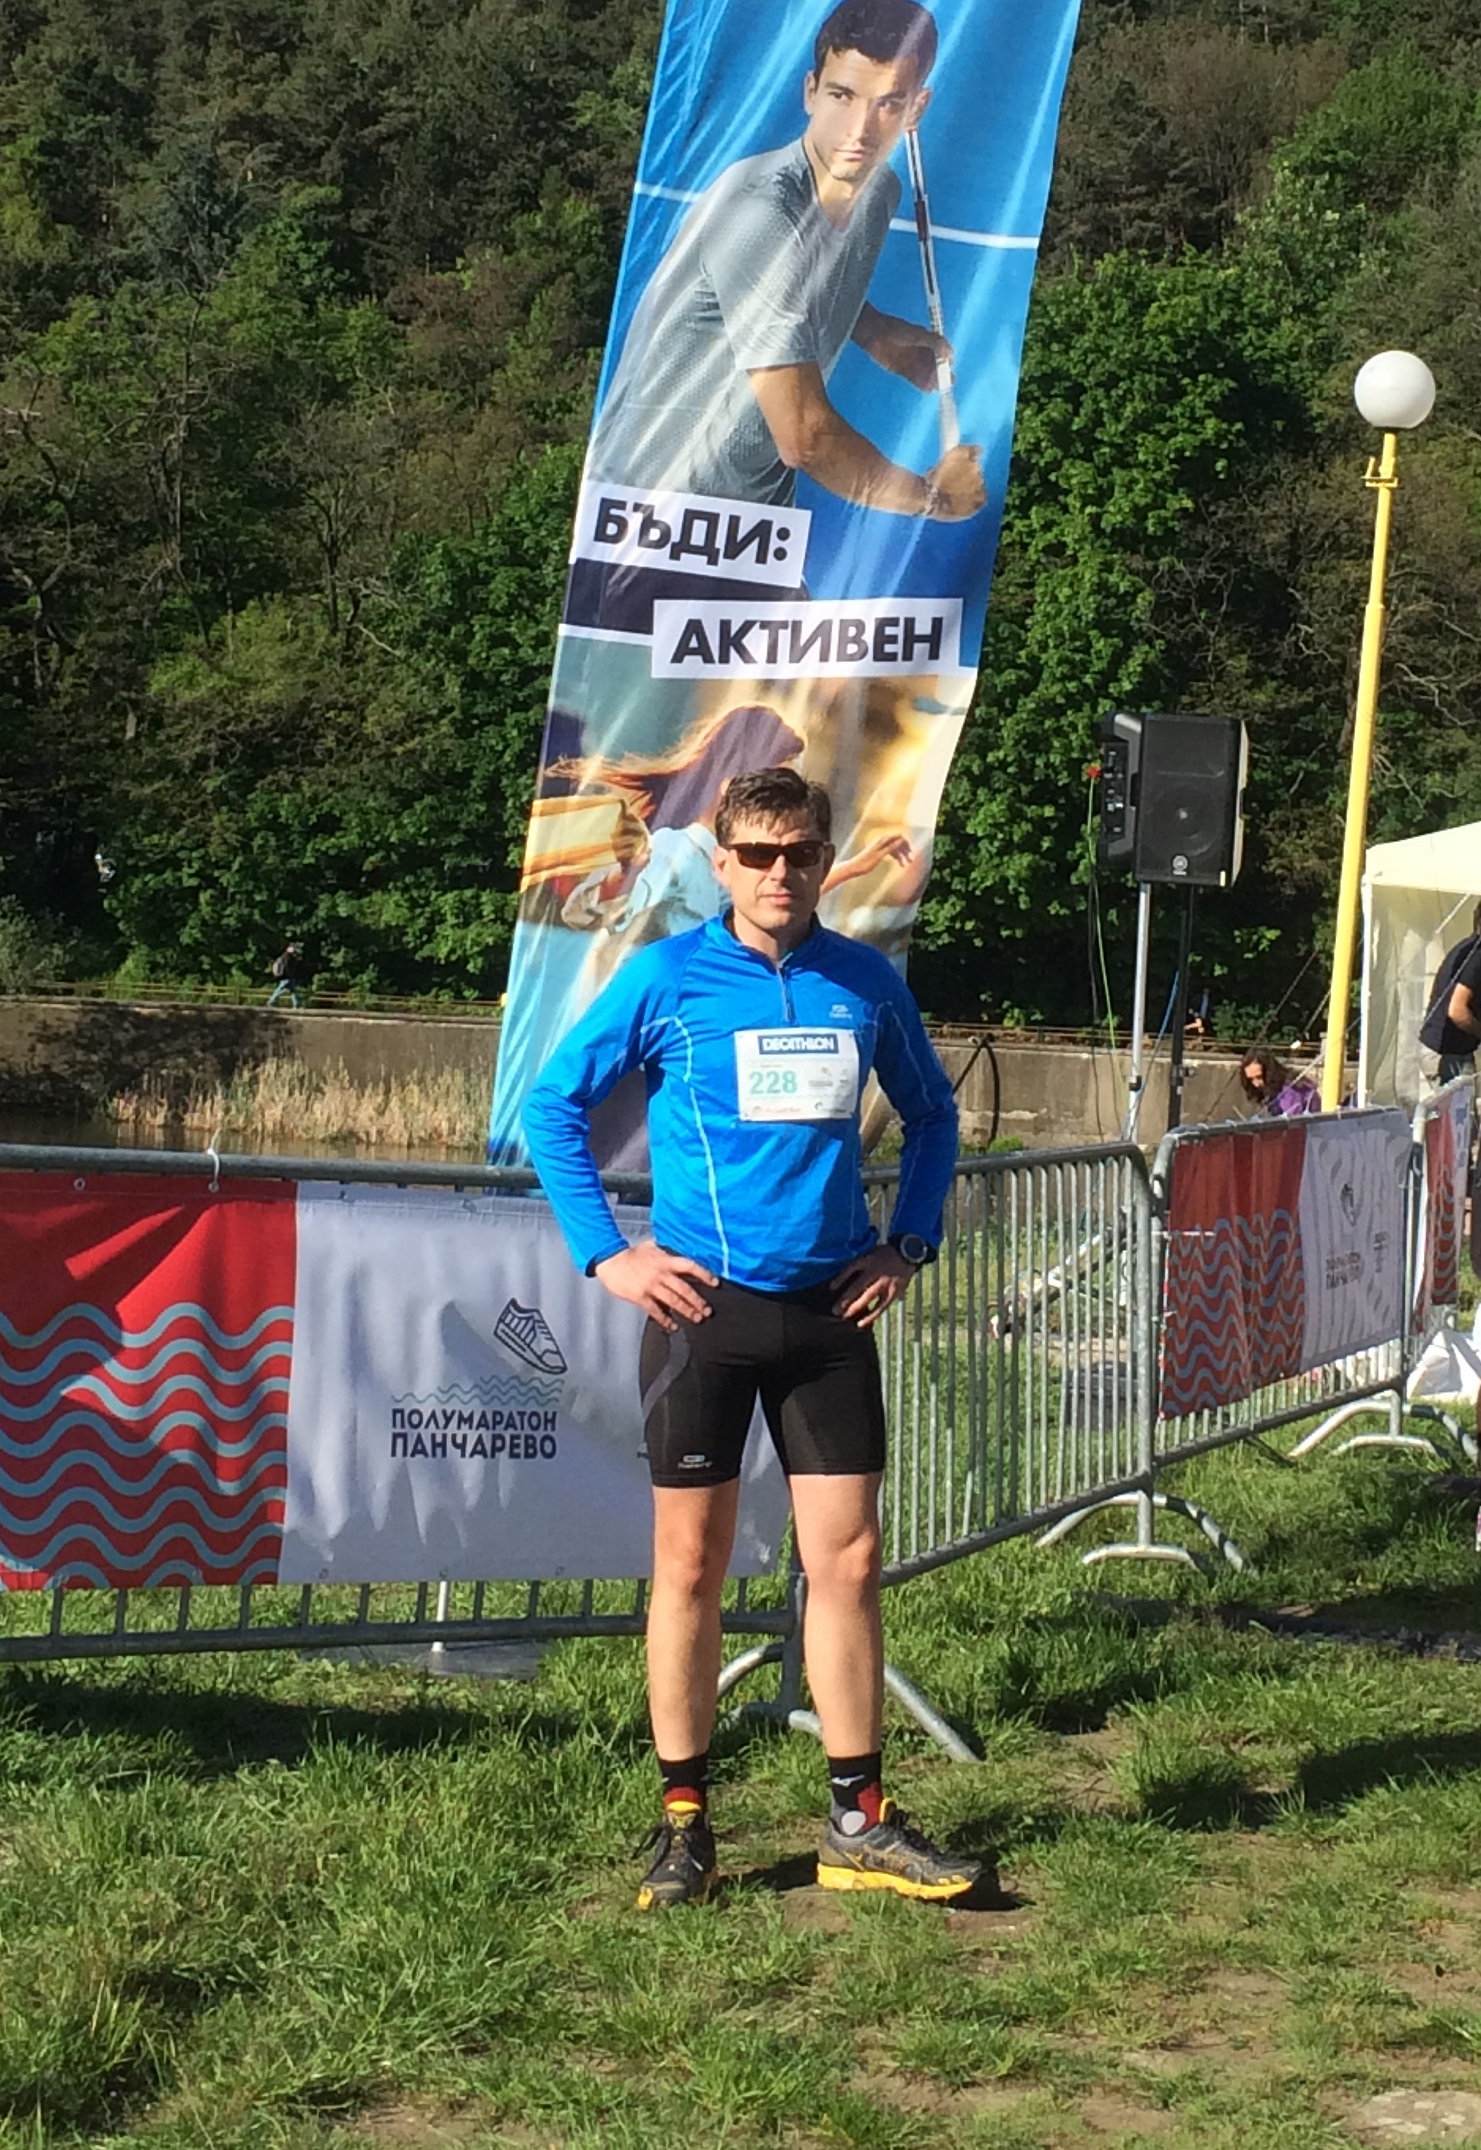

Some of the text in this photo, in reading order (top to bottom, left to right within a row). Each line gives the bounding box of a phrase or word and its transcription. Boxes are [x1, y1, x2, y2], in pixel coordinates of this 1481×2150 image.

[593, 497, 791, 567] БЪДИ:
[670, 616, 944, 665] АКТИВЕН
[762, 1037, 834, 1050] DECATHLON
[749, 1070, 798, 1094] 228
[391, 1408, 557, 1431] ПОЛУМАРАТОН
[390, 1432, 557, 1459] ПАНЧАРЕВО
